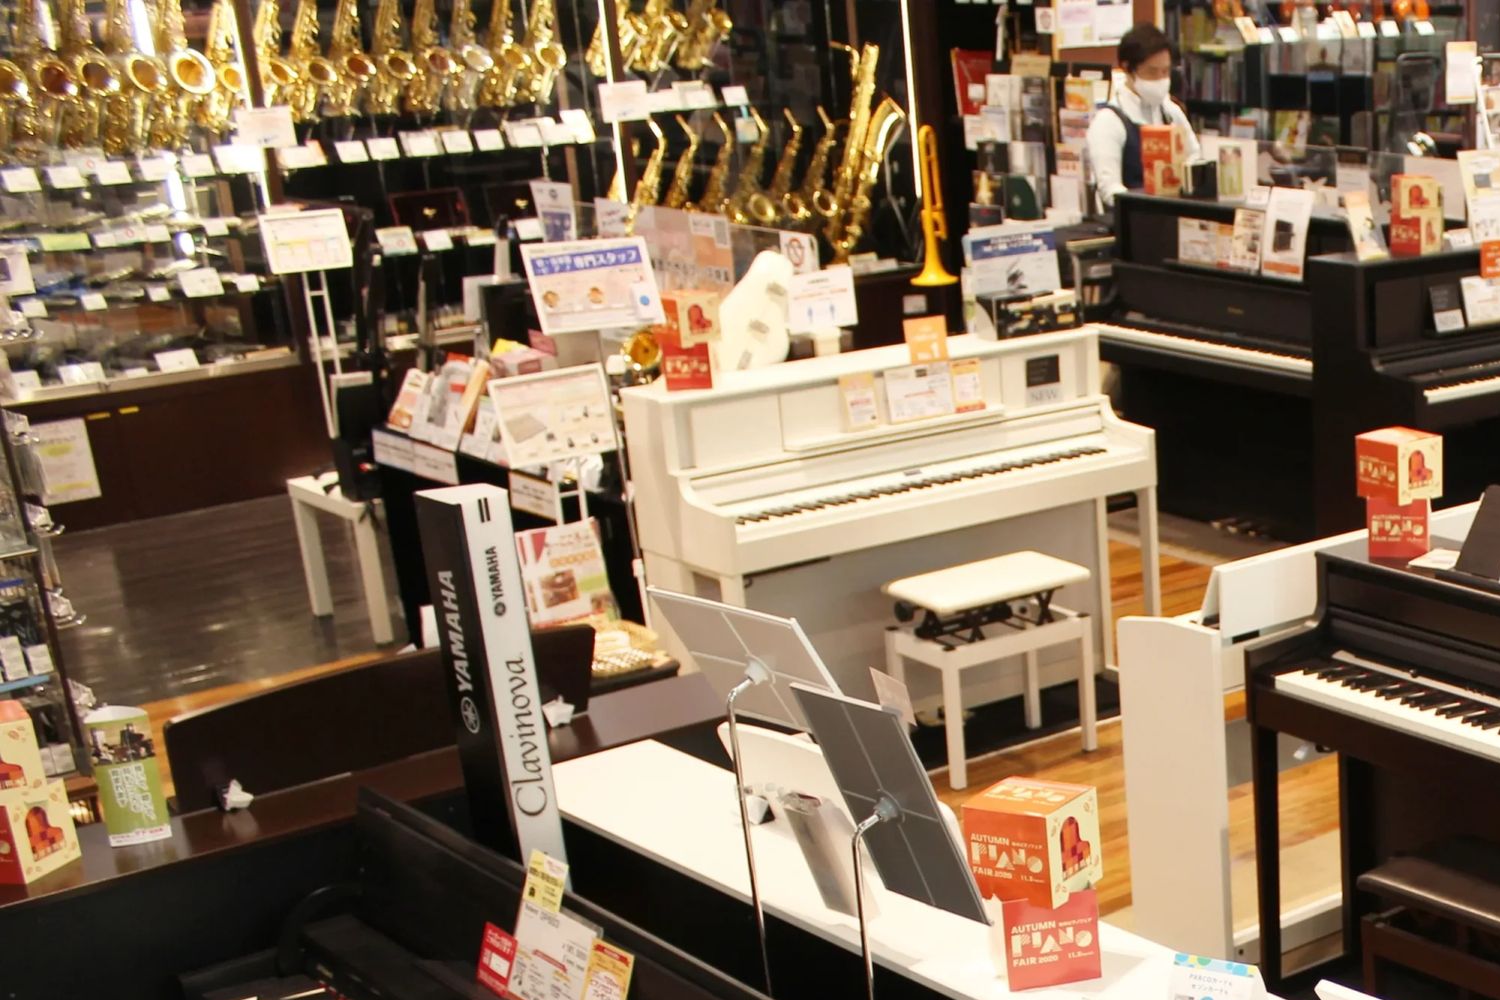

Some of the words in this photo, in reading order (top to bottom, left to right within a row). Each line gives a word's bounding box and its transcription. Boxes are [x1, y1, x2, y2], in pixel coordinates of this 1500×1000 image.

[484, 545, 501, 602] YAMAHA
[437, 570, 473, 692] YAMAHA
[505, 655, 548, 817] Clavinova
[970, 833, 1010, 846] AUTUMN
[970, 841, 1043, 874] PIANO
[972, 865, 993, 877] FAIR
[1011, 919, 1057, 935] AUTUMN
[1011, 926, 1093, 958] PIANO
[1013, 956, 1037, 967] FAIR
[1038, 954, 1059, 964] 2020
